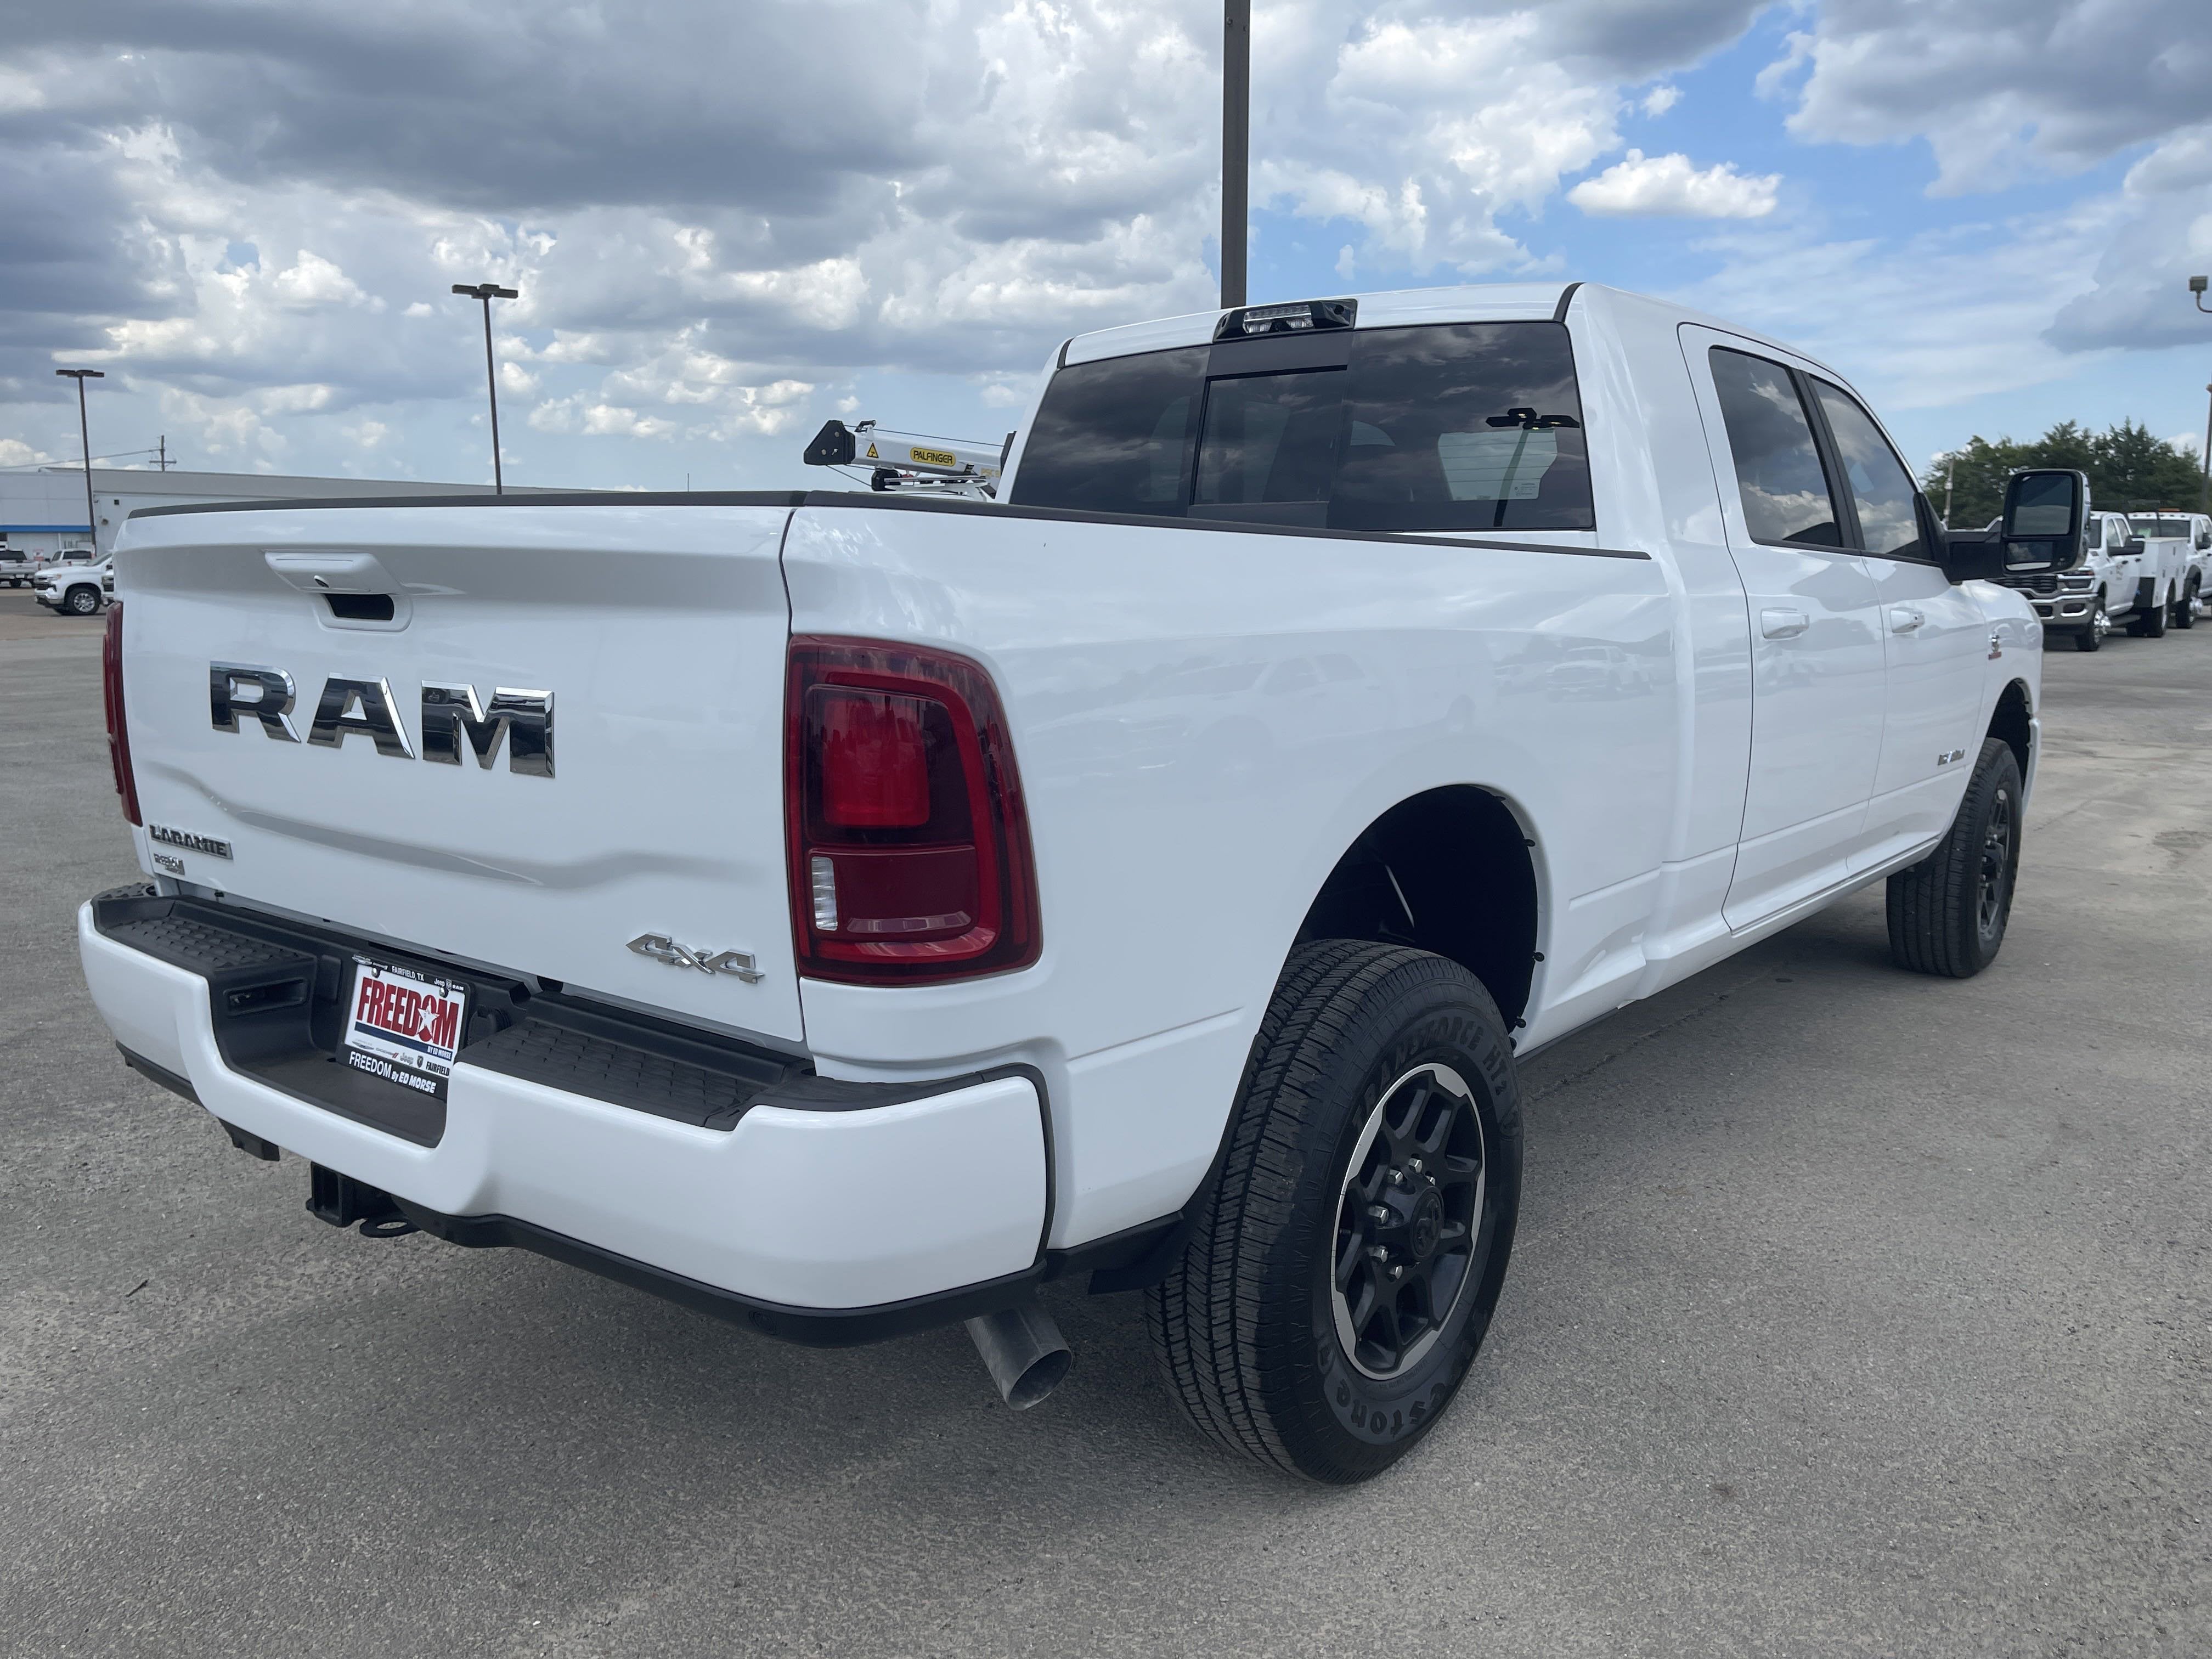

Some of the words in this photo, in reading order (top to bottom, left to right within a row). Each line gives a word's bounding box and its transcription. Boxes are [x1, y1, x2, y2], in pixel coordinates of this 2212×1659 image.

[913, 450, 953, 464] PALFINGER
[210, 661, 555, 778] RAM
[417, 973, 425, 982] TX
[434, 978, 445, 987] Jeep
[356, 977, 459, 1049] FREEDOM
[400, 1052, 414, 1065] Jeep
[349, 1051, 392, 1079] FREEDOM
[398, 1071, 409, 1085] ED
[409, 1075, 437, 1094] MORSE
[426, 1061, 450, 1076] FAIRFIELD
